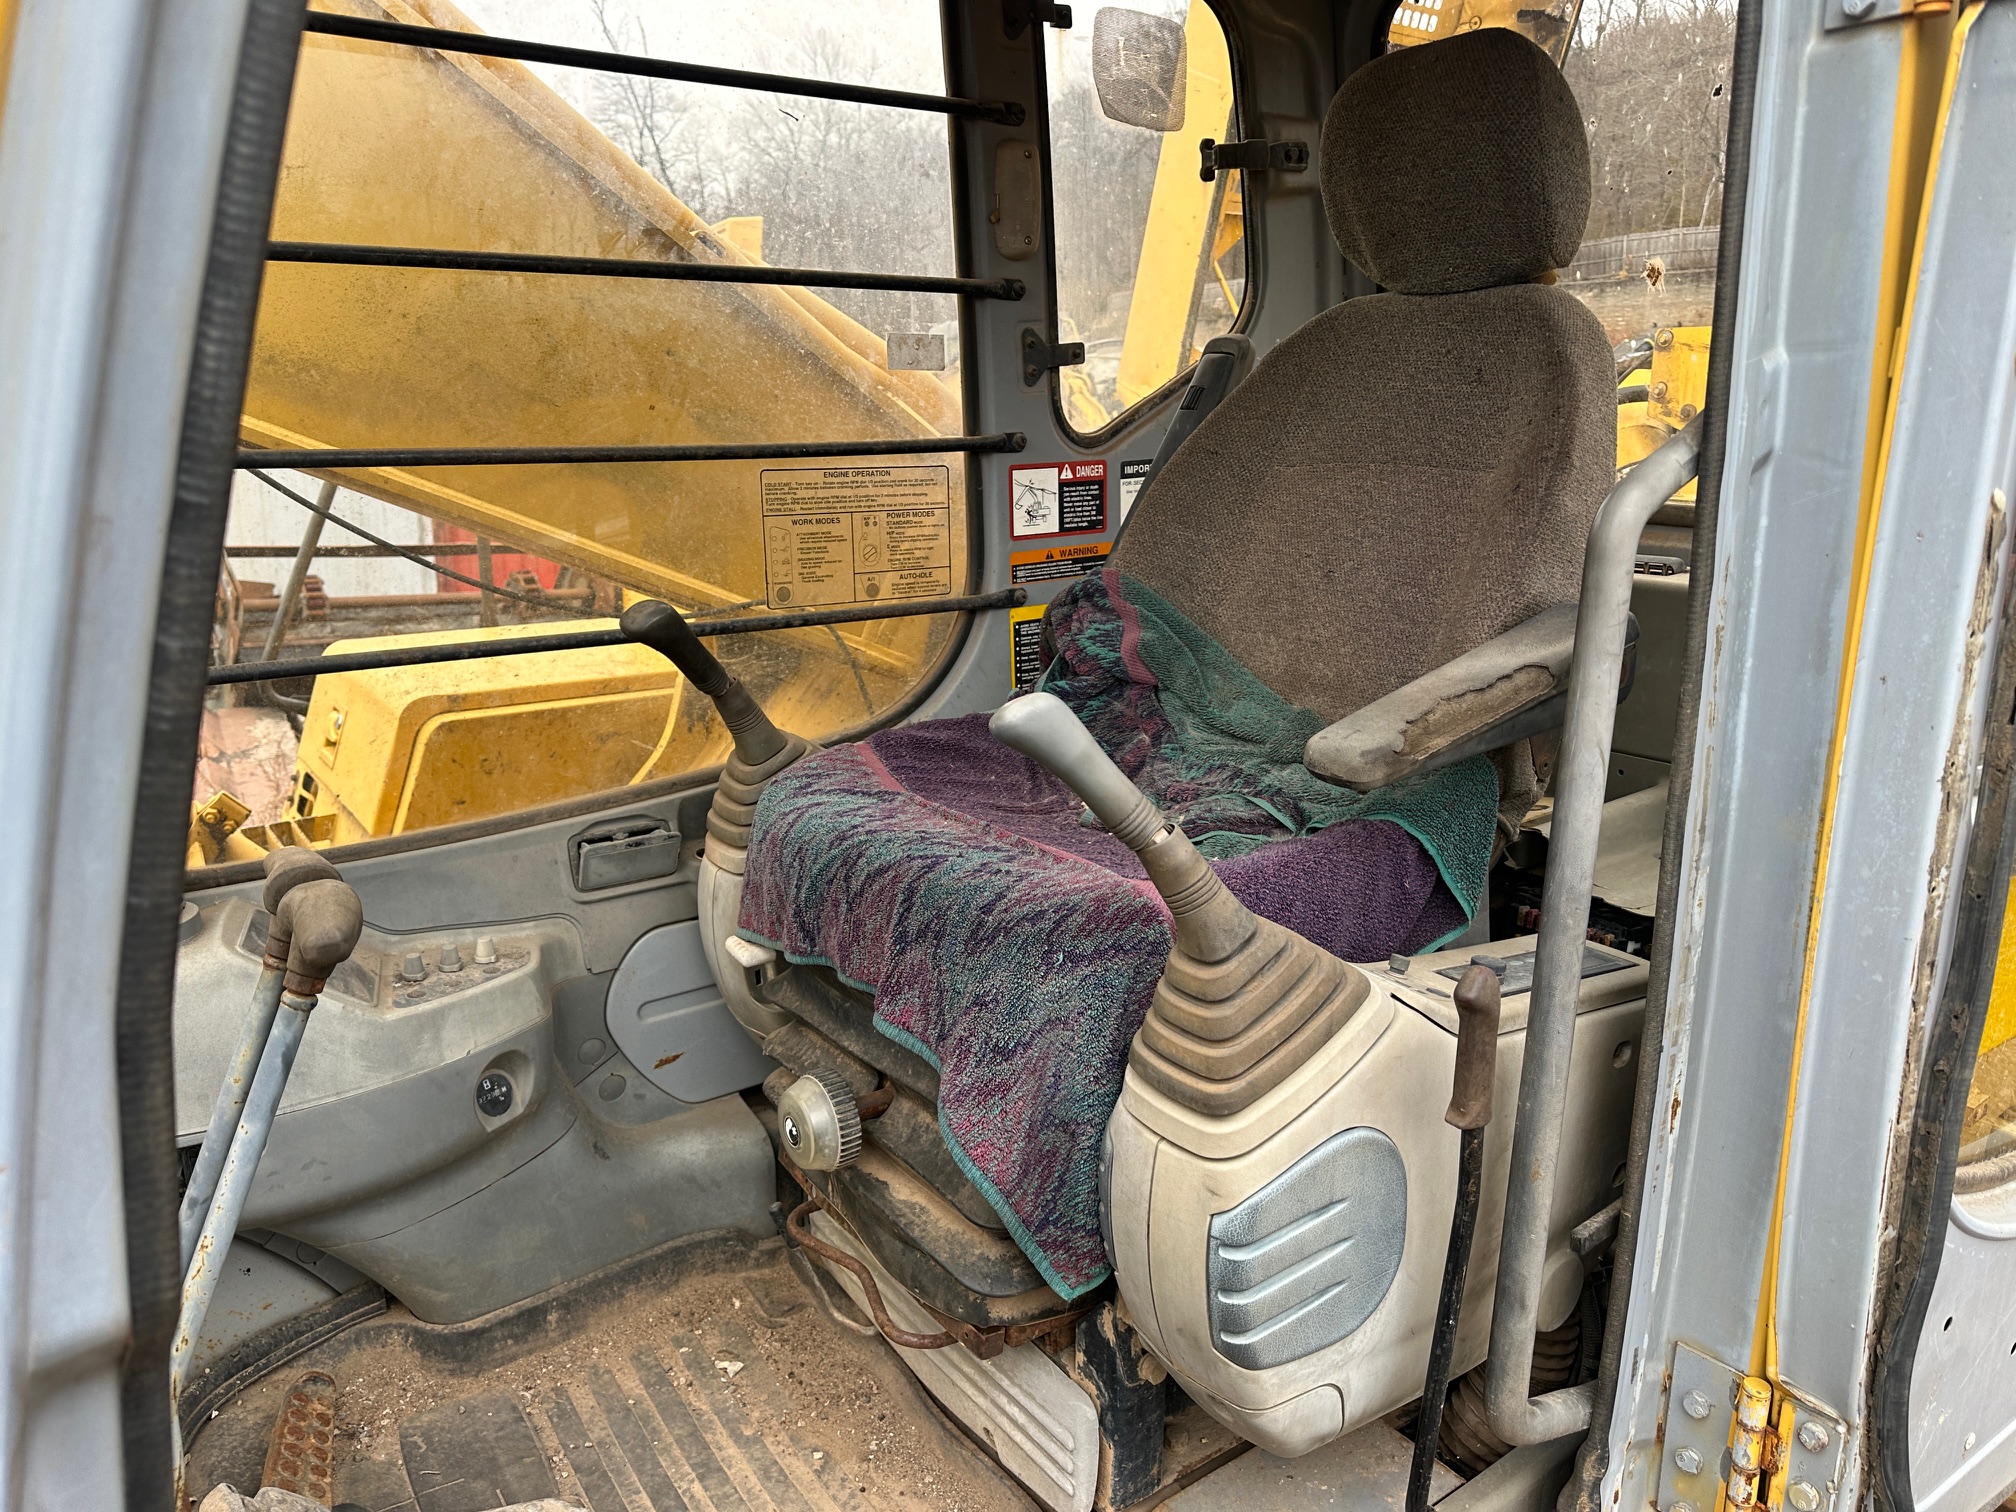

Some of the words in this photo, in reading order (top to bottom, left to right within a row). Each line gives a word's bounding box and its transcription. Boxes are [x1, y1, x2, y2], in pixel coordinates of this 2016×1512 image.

[1076, 465, 1103, 477] DANGER
[1125, 464, 1152, 474] IMPOR
[1059, 546, 1098, 558] WARNING
